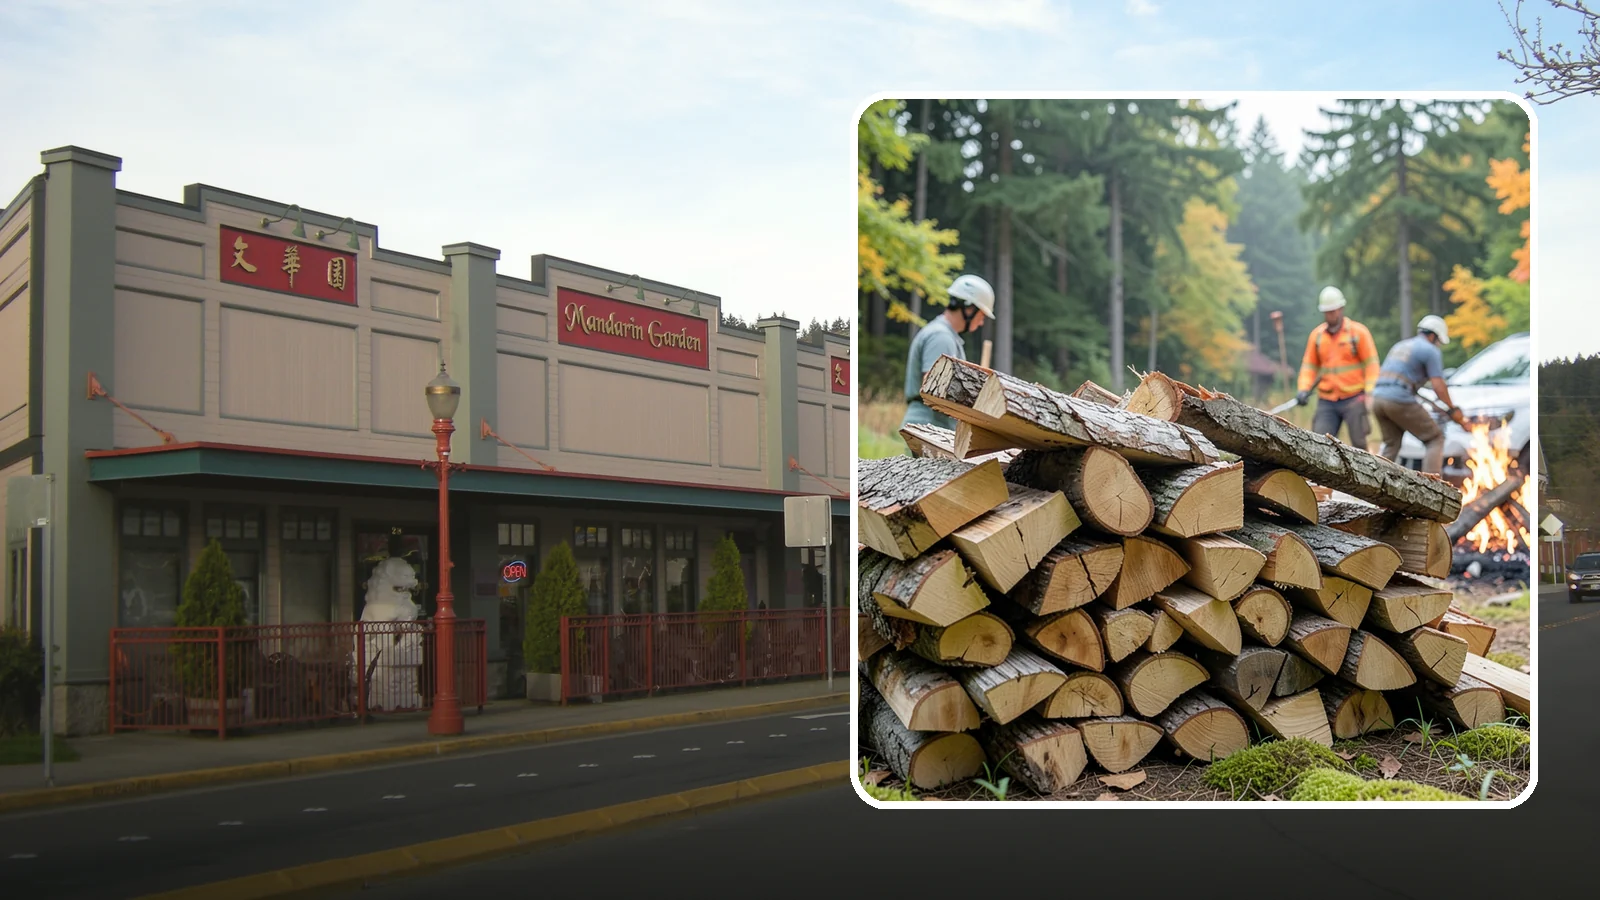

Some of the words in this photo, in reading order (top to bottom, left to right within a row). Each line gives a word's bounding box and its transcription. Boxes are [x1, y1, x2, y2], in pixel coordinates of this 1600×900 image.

[230, 235, 347, 291] 文華園
[564, 302, 644, 341] Mandarin
[647, 320, 702, 352] Garden
[503, 565, 527, 578] OPEN
